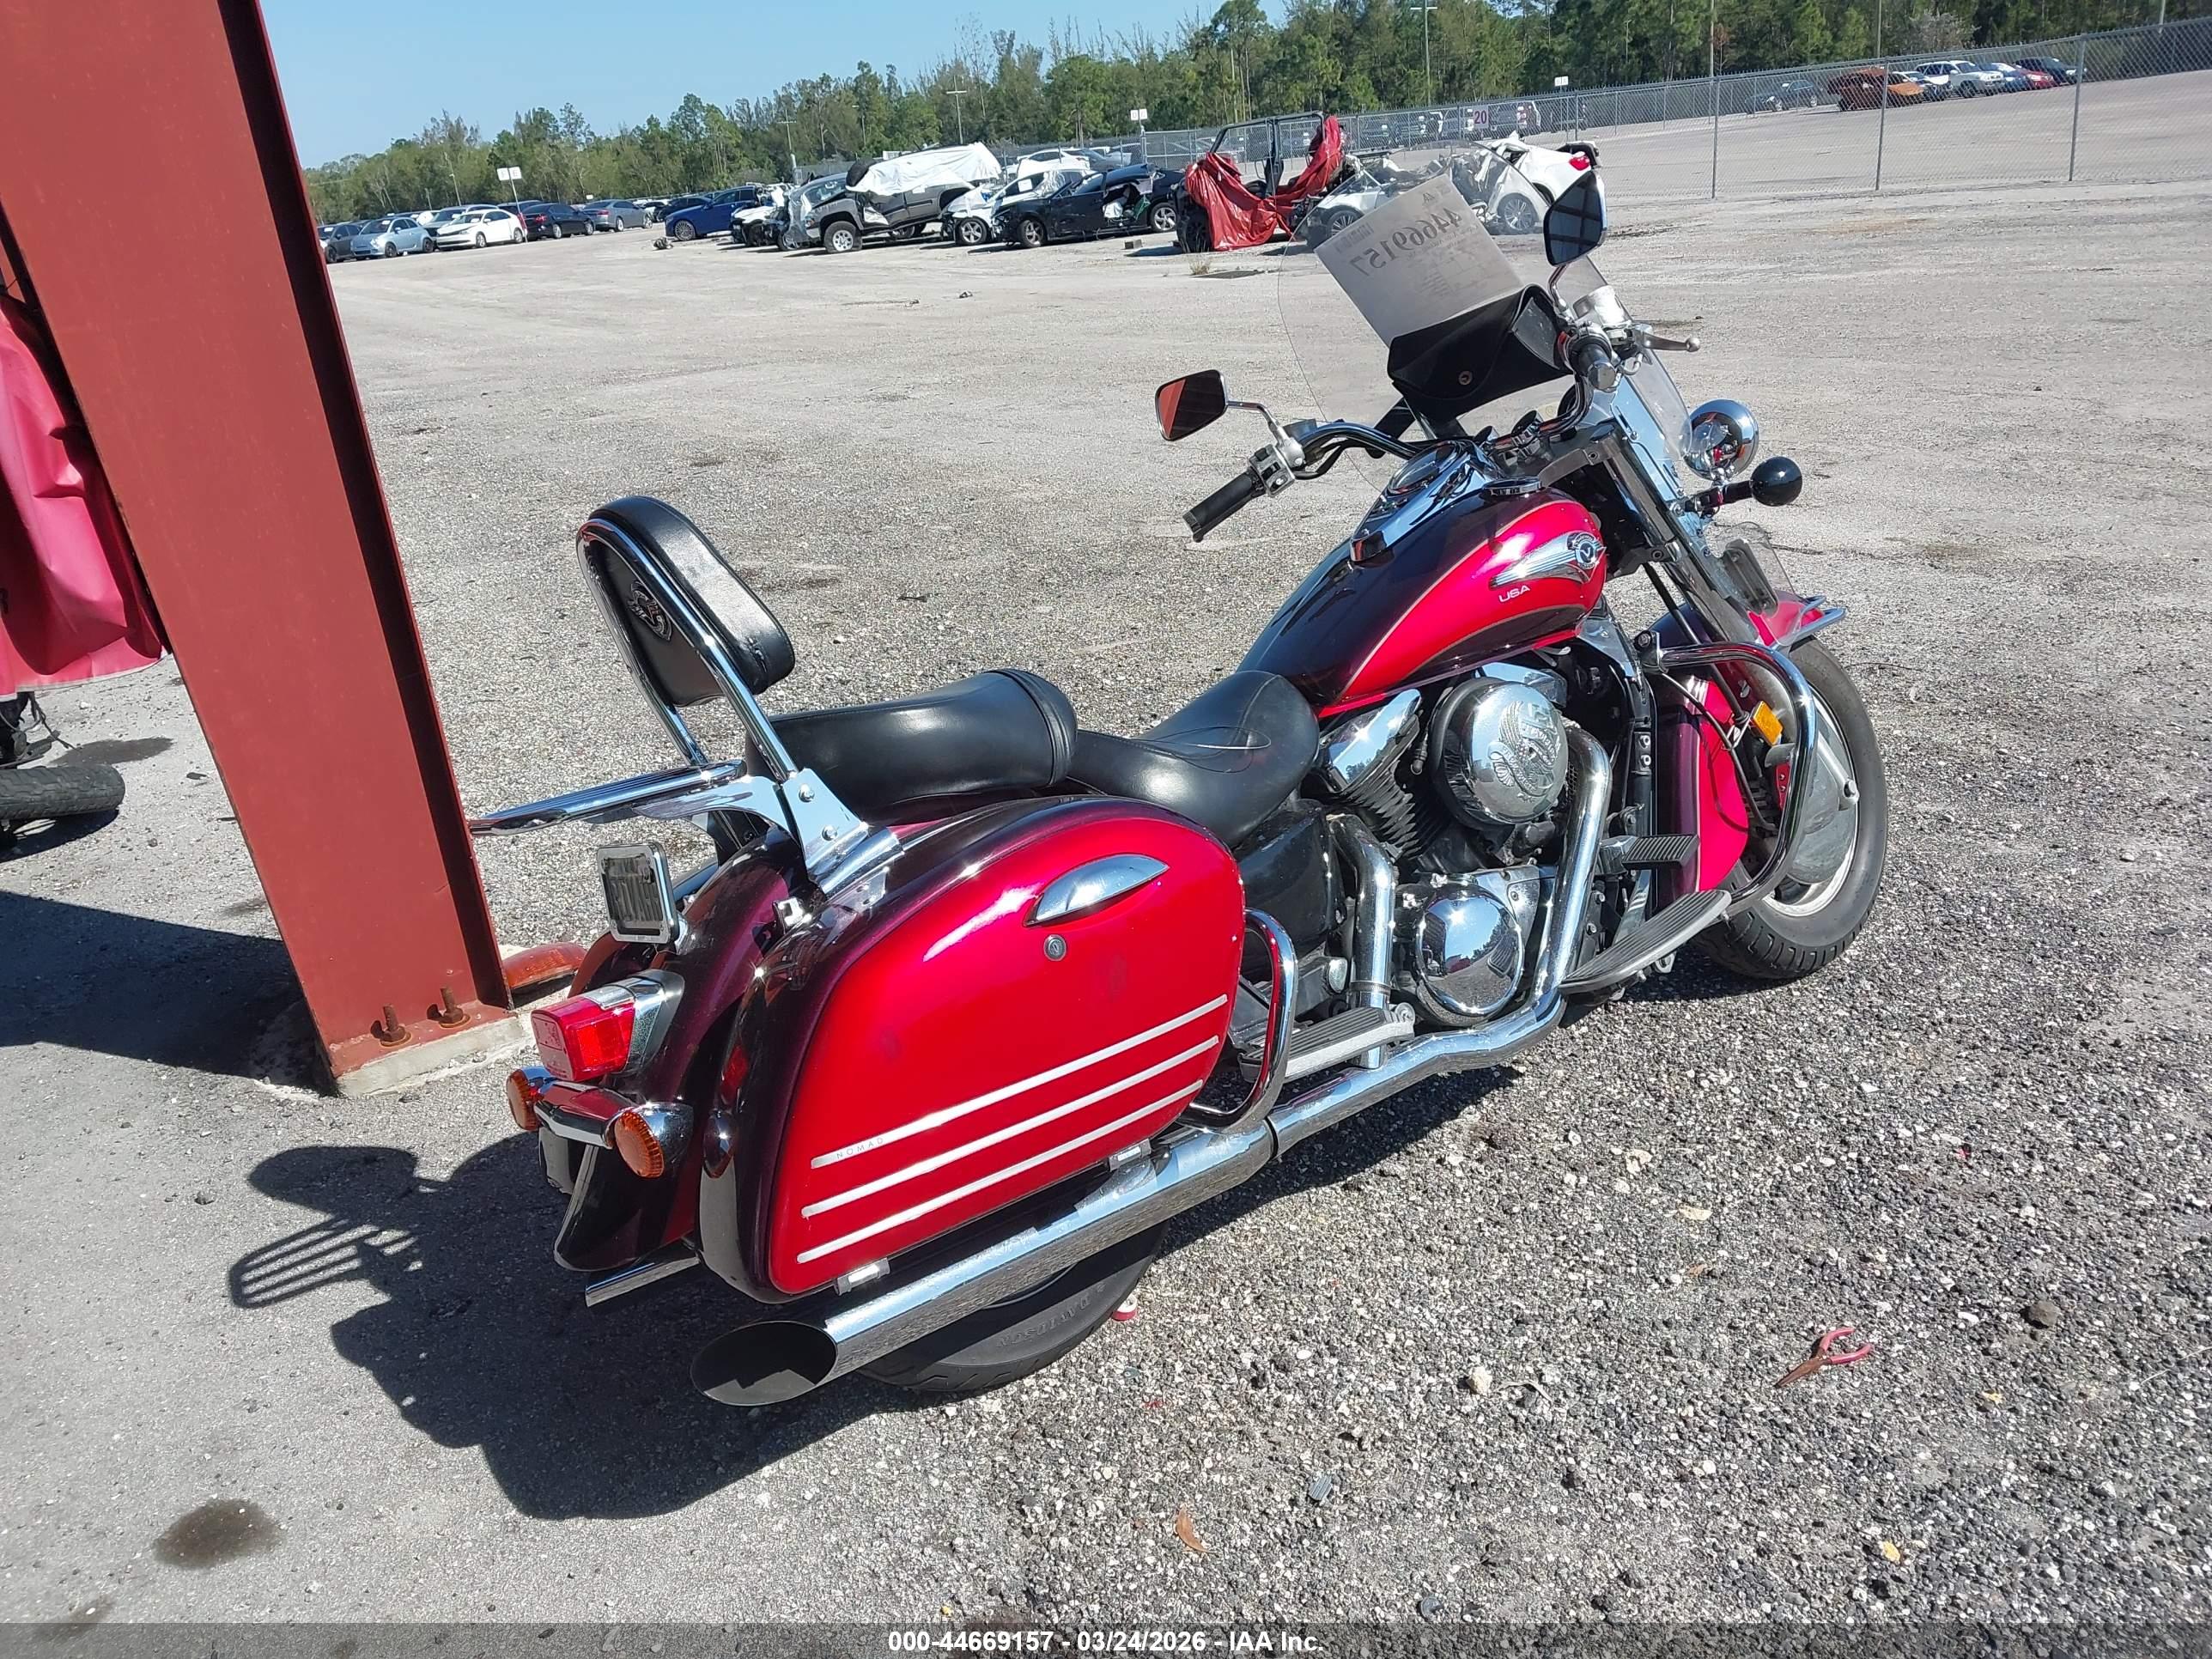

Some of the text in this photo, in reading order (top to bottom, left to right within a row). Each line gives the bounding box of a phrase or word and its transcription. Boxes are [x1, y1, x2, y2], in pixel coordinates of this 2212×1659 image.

[1474, 110, 1487, 124] 20
[1498, 585, 1530, 603] USA
[837, 1137, 883, 1158] NOMAD
